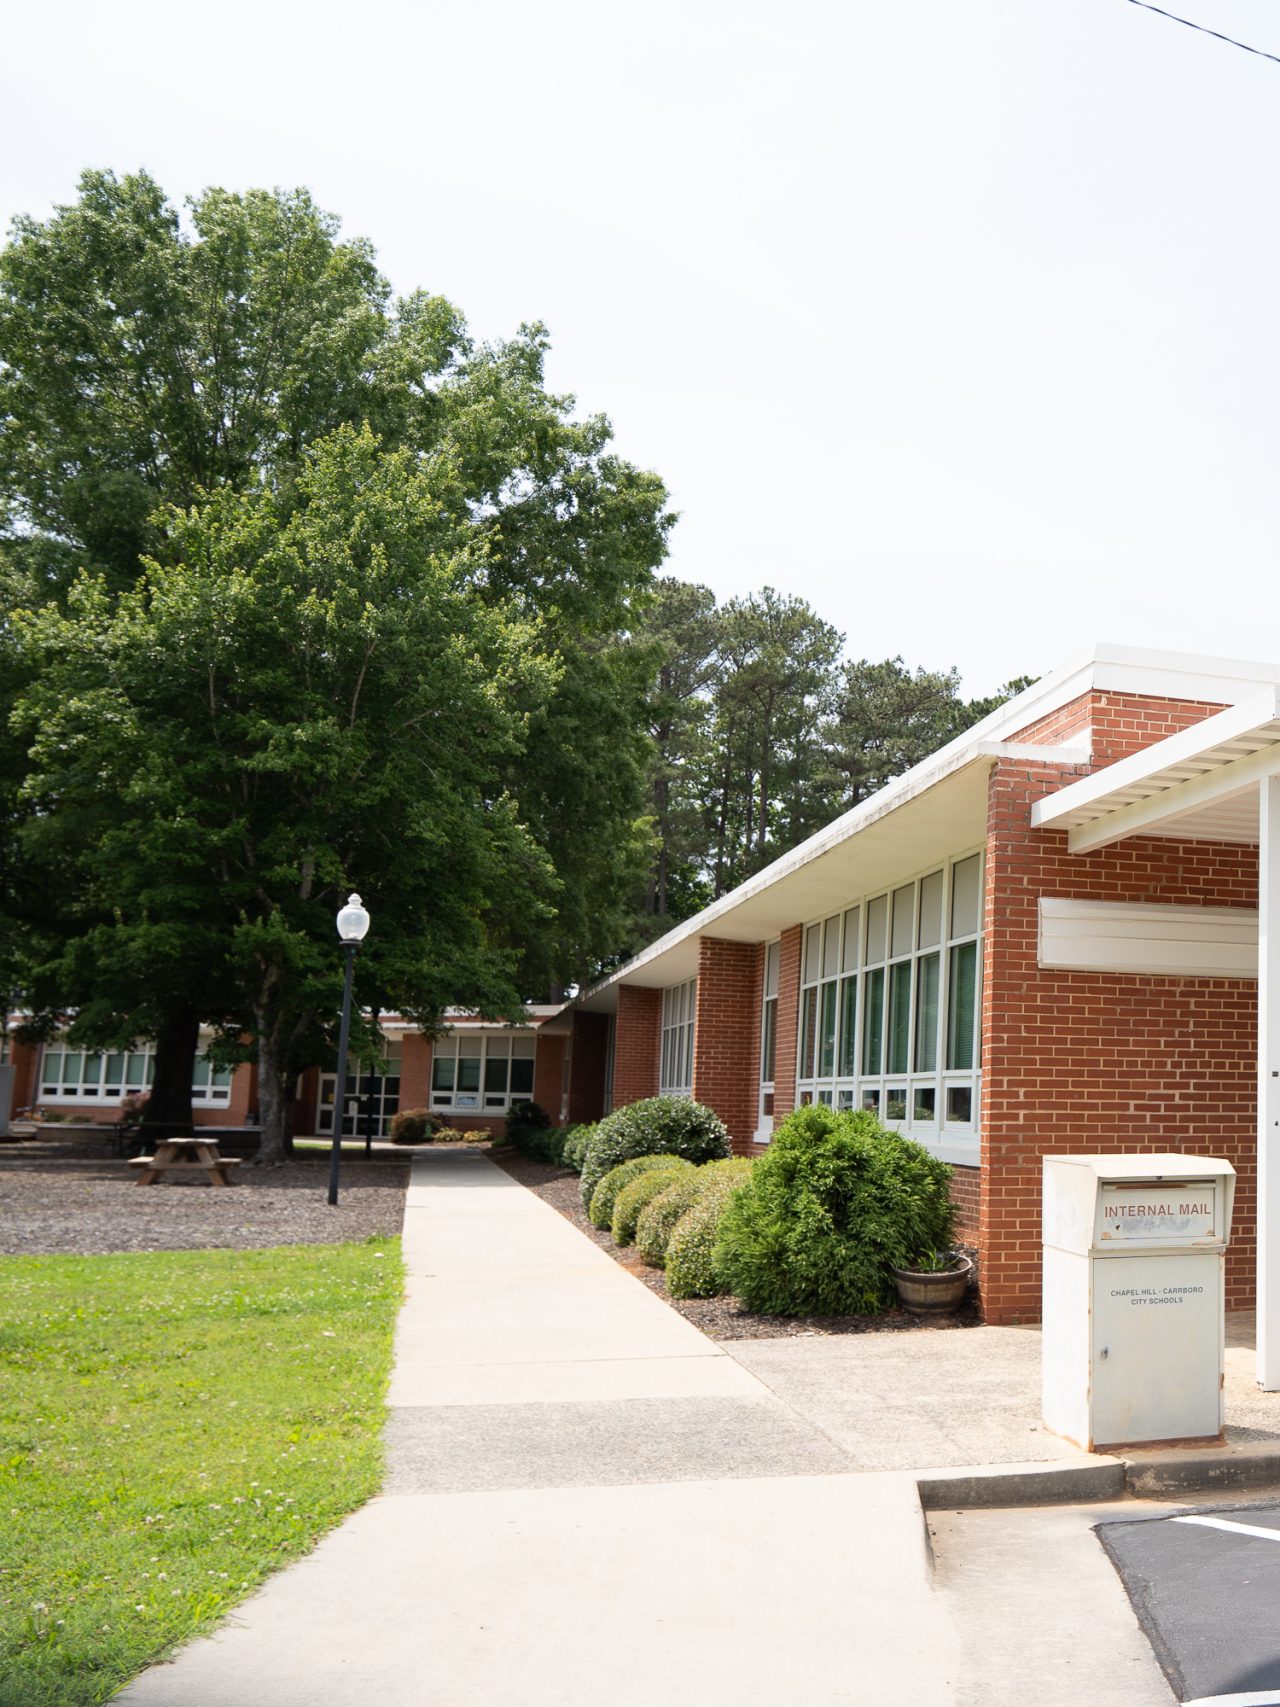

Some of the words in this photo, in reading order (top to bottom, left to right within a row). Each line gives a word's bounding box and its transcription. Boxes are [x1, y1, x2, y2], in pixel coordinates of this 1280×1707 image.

[1104, 1204, 1174, 1217] INTERNAL
[1179, 1203, 1211, 1215] MAIL
[1110, 1288, 1139, 1296] CHAPEL
[1141, 1287, 1157, 1295] HILL
[1163, 1286, 1203, 1294] CARRBORO
